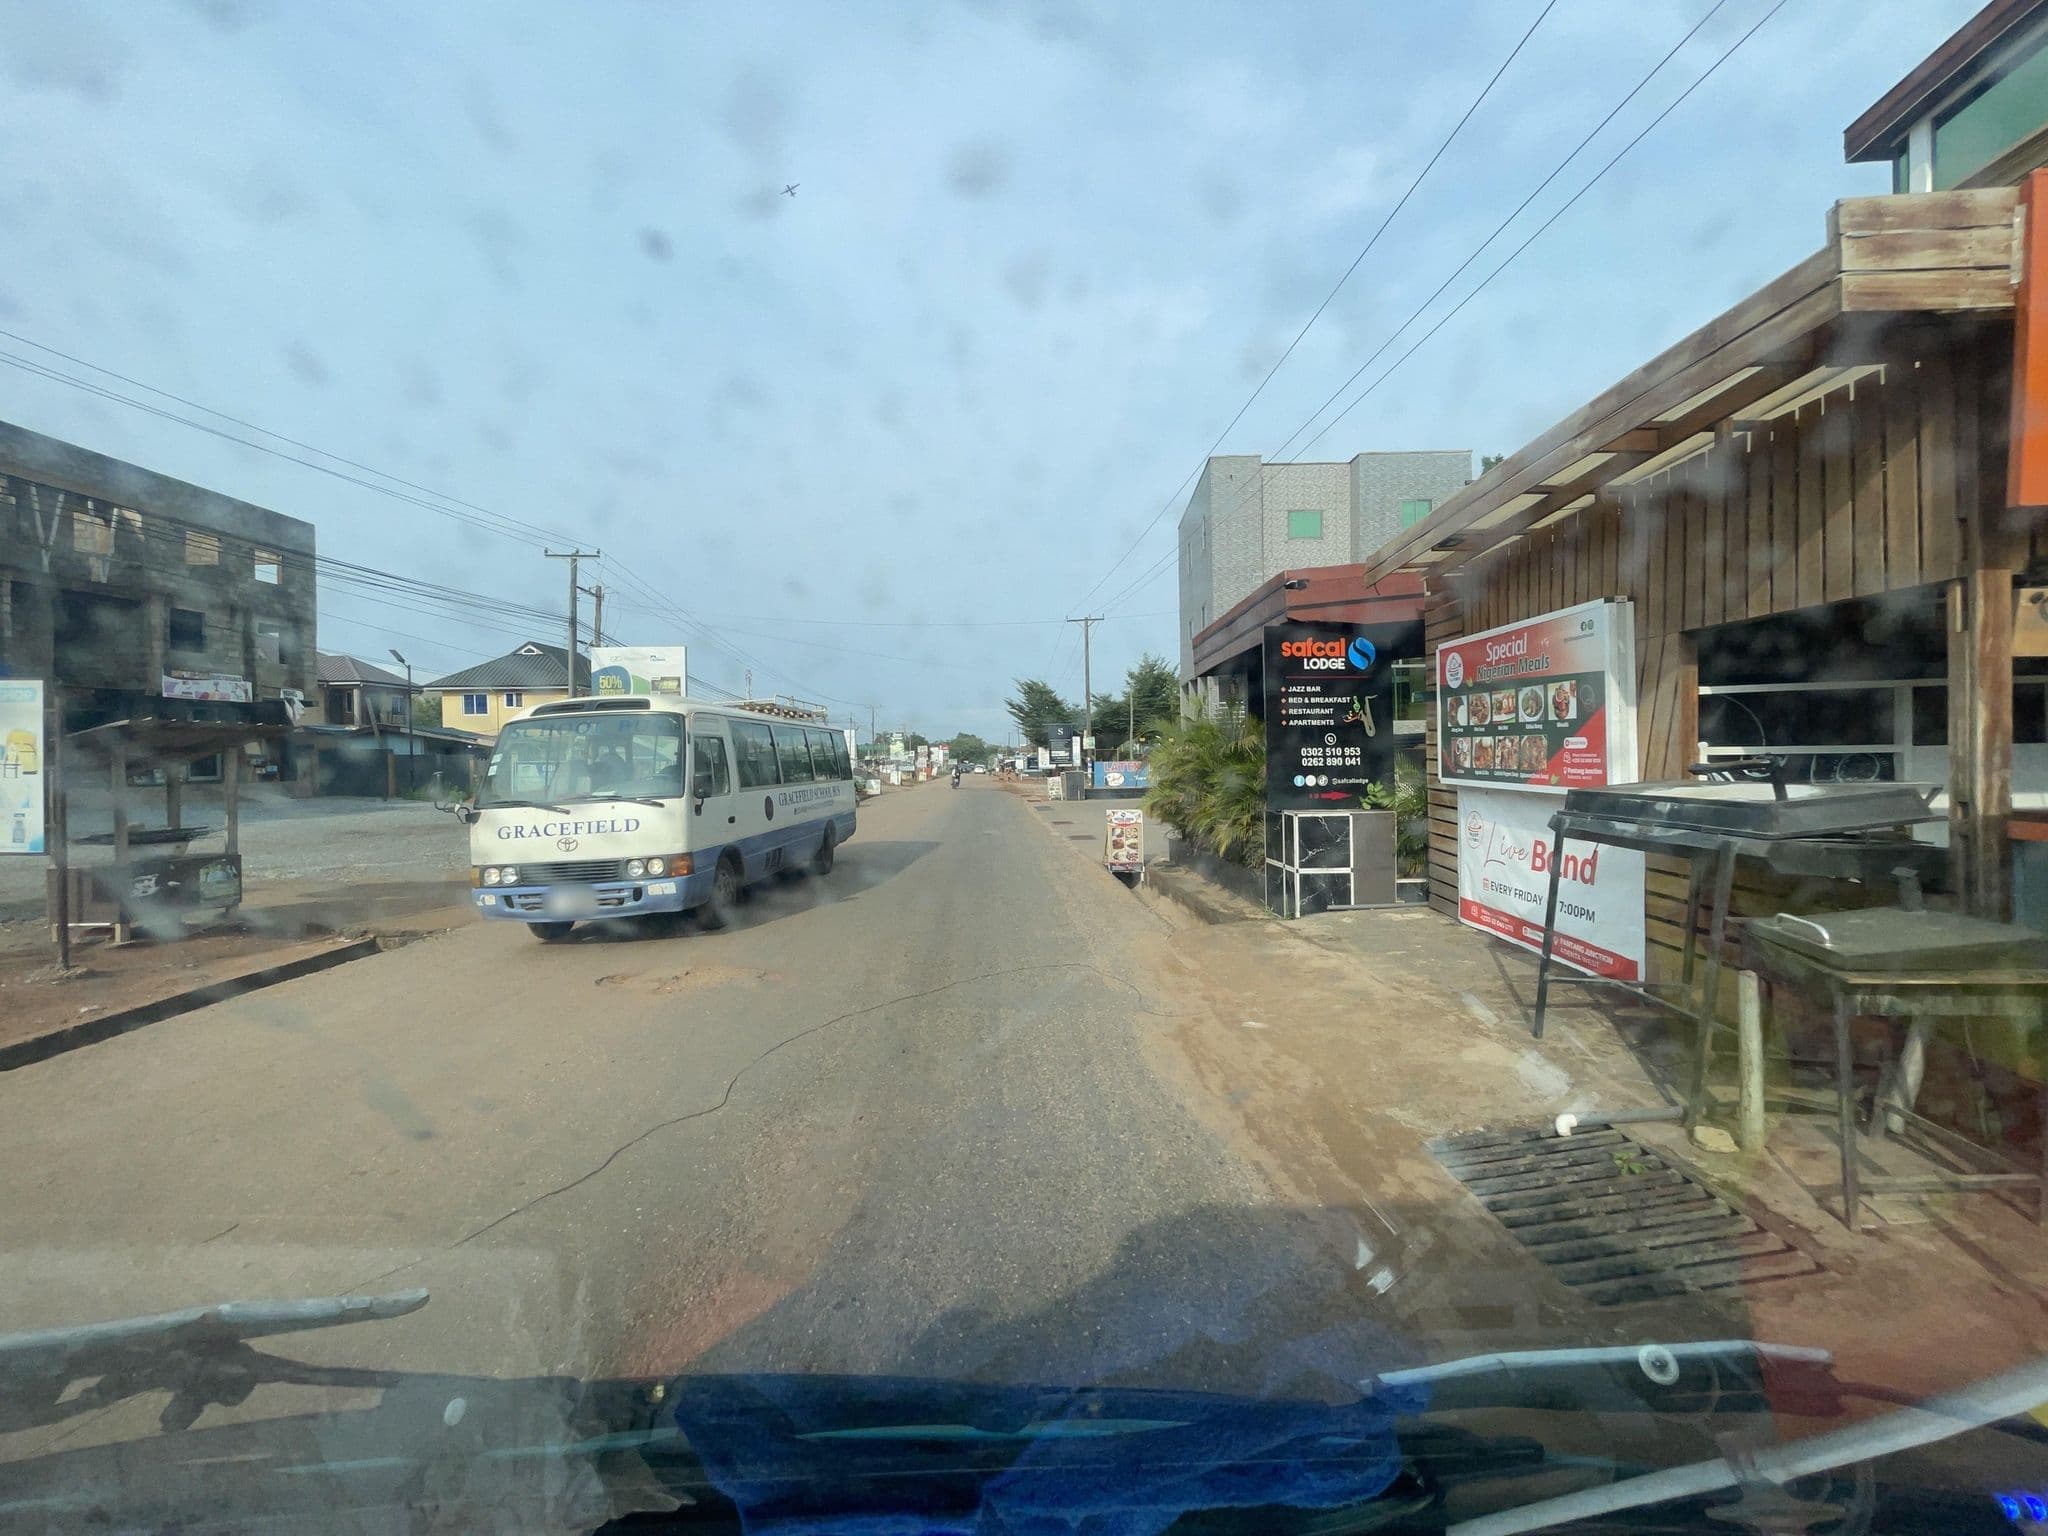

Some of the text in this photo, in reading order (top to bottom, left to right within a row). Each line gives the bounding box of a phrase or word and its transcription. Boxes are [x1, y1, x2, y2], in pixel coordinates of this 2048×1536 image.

[1486, 633, 1528, 665] Special
[1303, 657, 1346, 670] LODGE
[1476, 660, 1516, 684] Nigerian
[1517, 654, 1550, 674] Meals
[598, 675, 623, 689] 50%
[1311, 696, 1351, 704] BREAKFAST
[1301, 747, 1361, 757] 0302 510 953
[1301, 757, 1361, 767] 0262 890 041
[497, 817, 641, 840] GRACEFIELD
[1483, 821, 1530, 868] Live
[1490, 880, 1596, 923] EVERY FRIDAY 7:00PM
